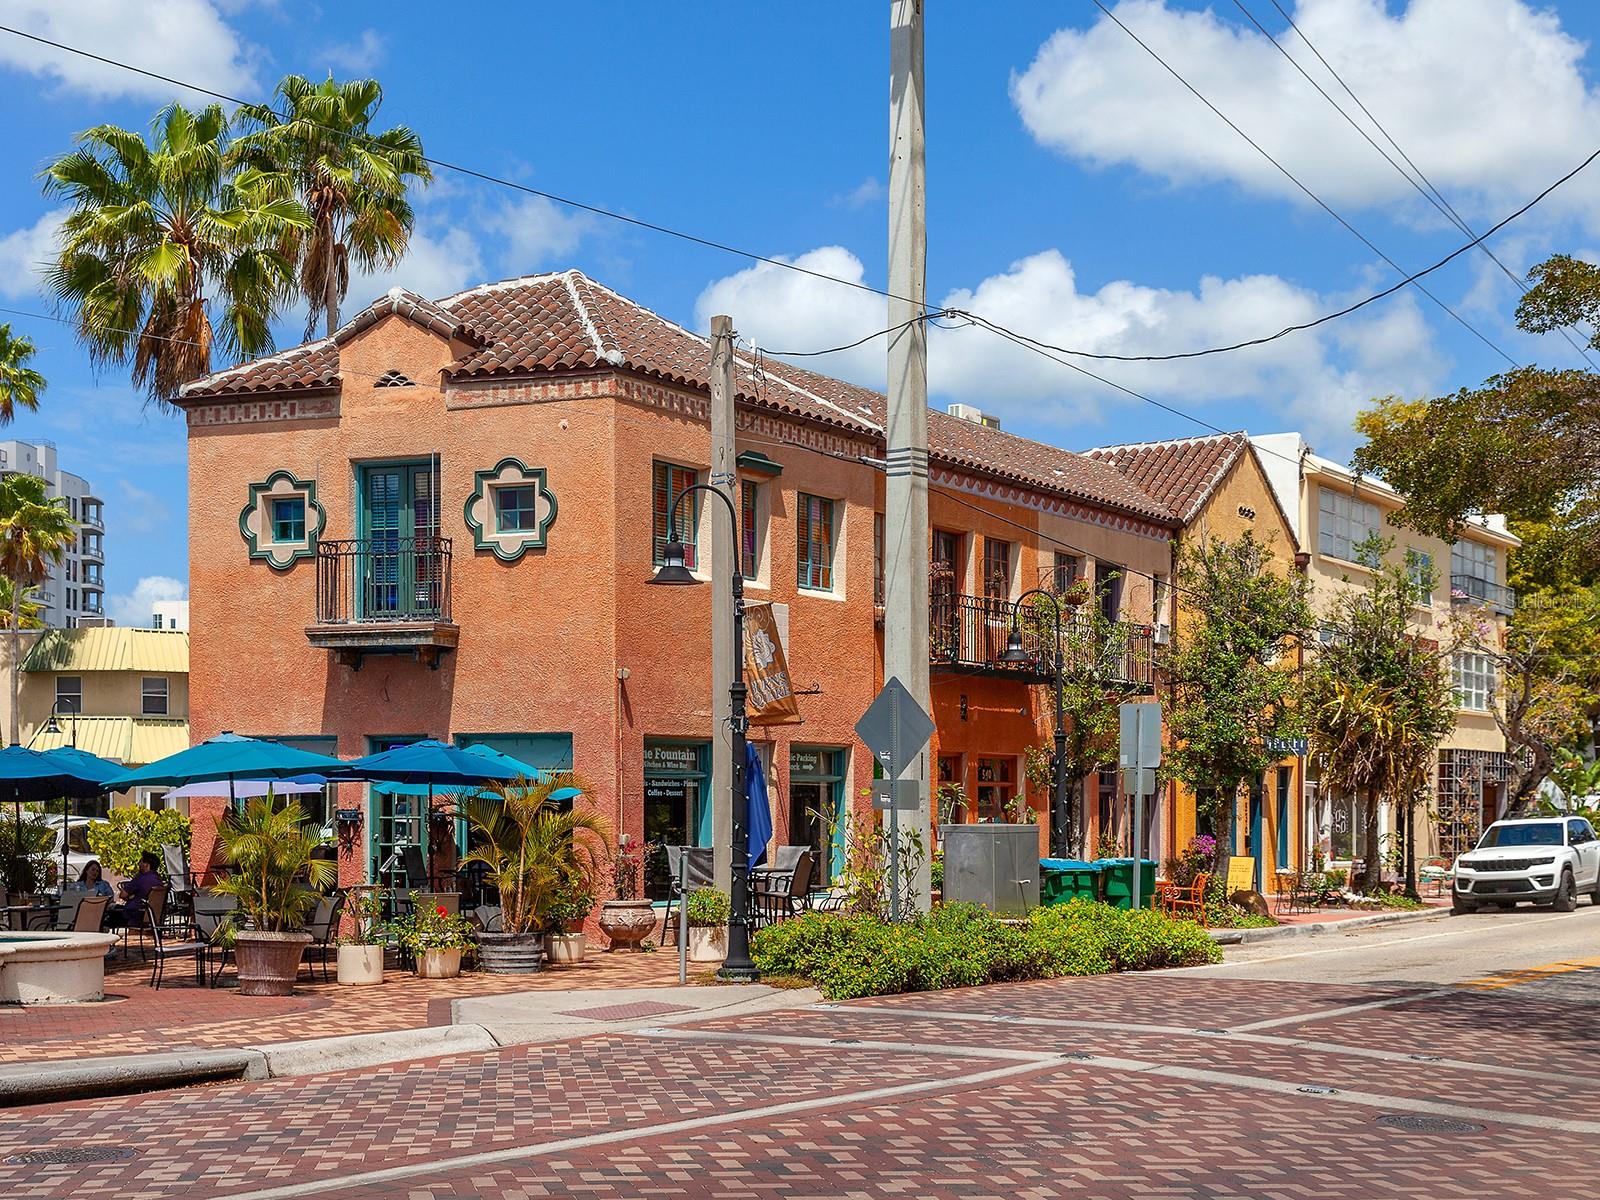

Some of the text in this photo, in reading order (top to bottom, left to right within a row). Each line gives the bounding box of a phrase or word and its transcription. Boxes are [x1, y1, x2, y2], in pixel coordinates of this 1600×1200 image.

[654, 748, 696, 761] Fountain
[796, 753, 818, 764] Parking
[651, 779, 681, 787] Sandwiches
[647, 789, 684, 797] Coffee Dessert
